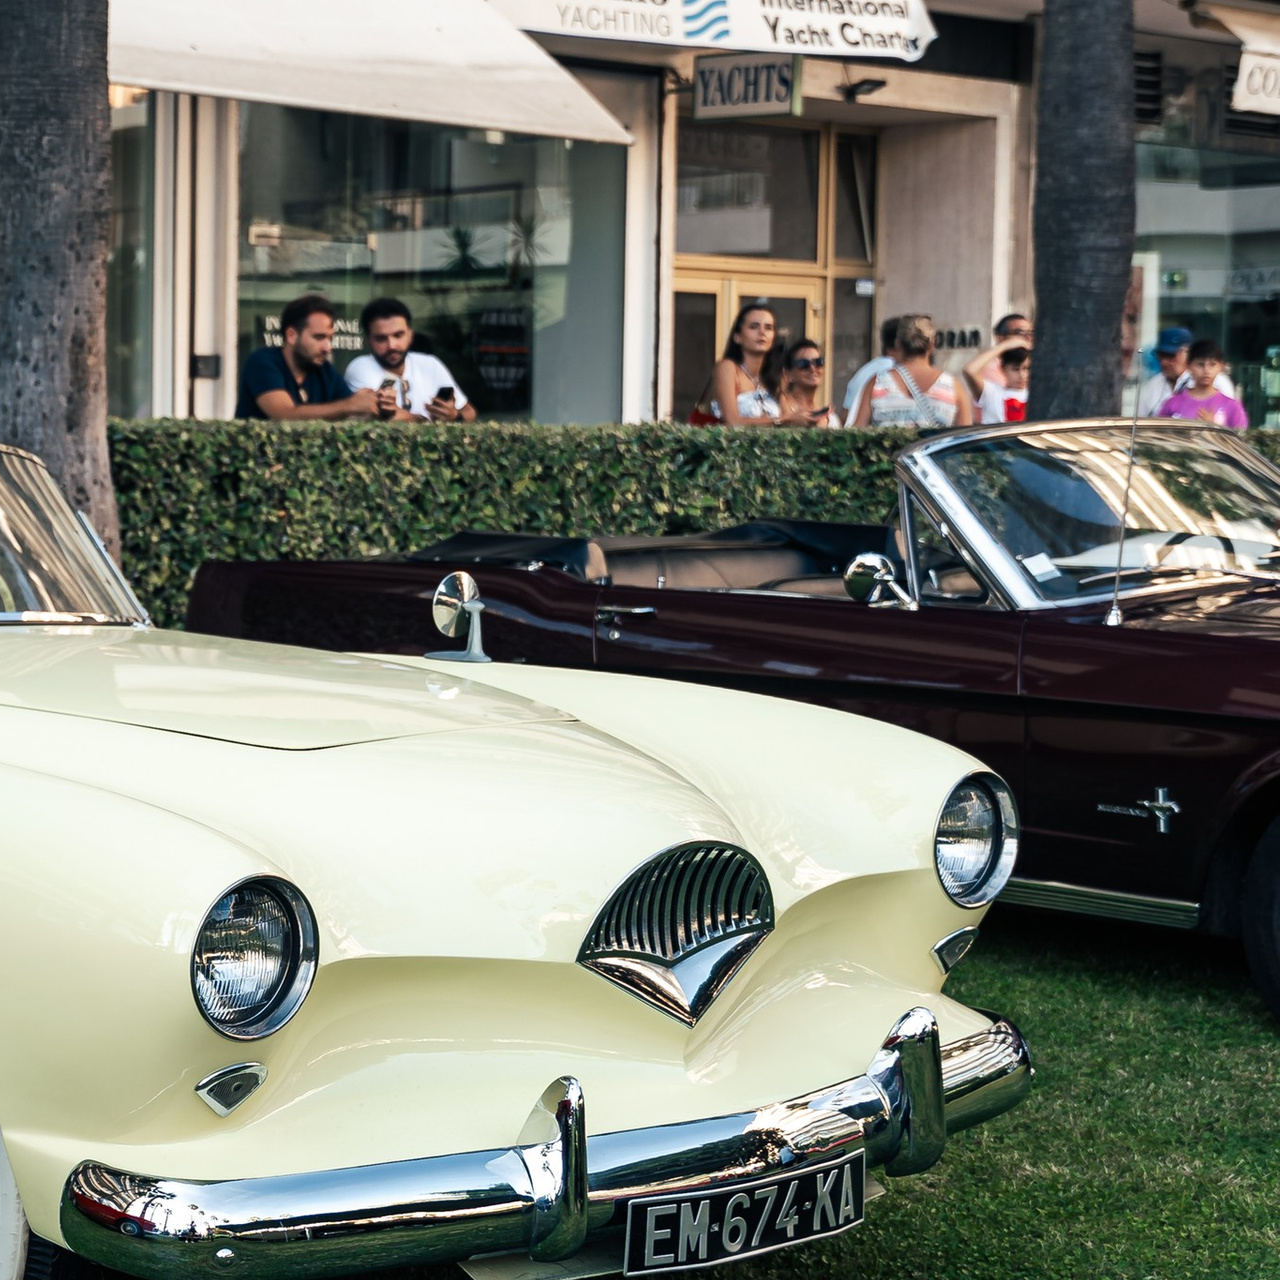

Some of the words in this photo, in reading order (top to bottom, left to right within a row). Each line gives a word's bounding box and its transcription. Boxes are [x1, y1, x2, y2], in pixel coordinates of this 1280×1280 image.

[556, 4, 672, 37] YACHTING
[764, 15, 833, 50] Yacht
[697, 60, 792, 108] YACHTS
[1246, 63, 1280, 99] CO
[644, 1164, 855, 1267] EM-674-KA
